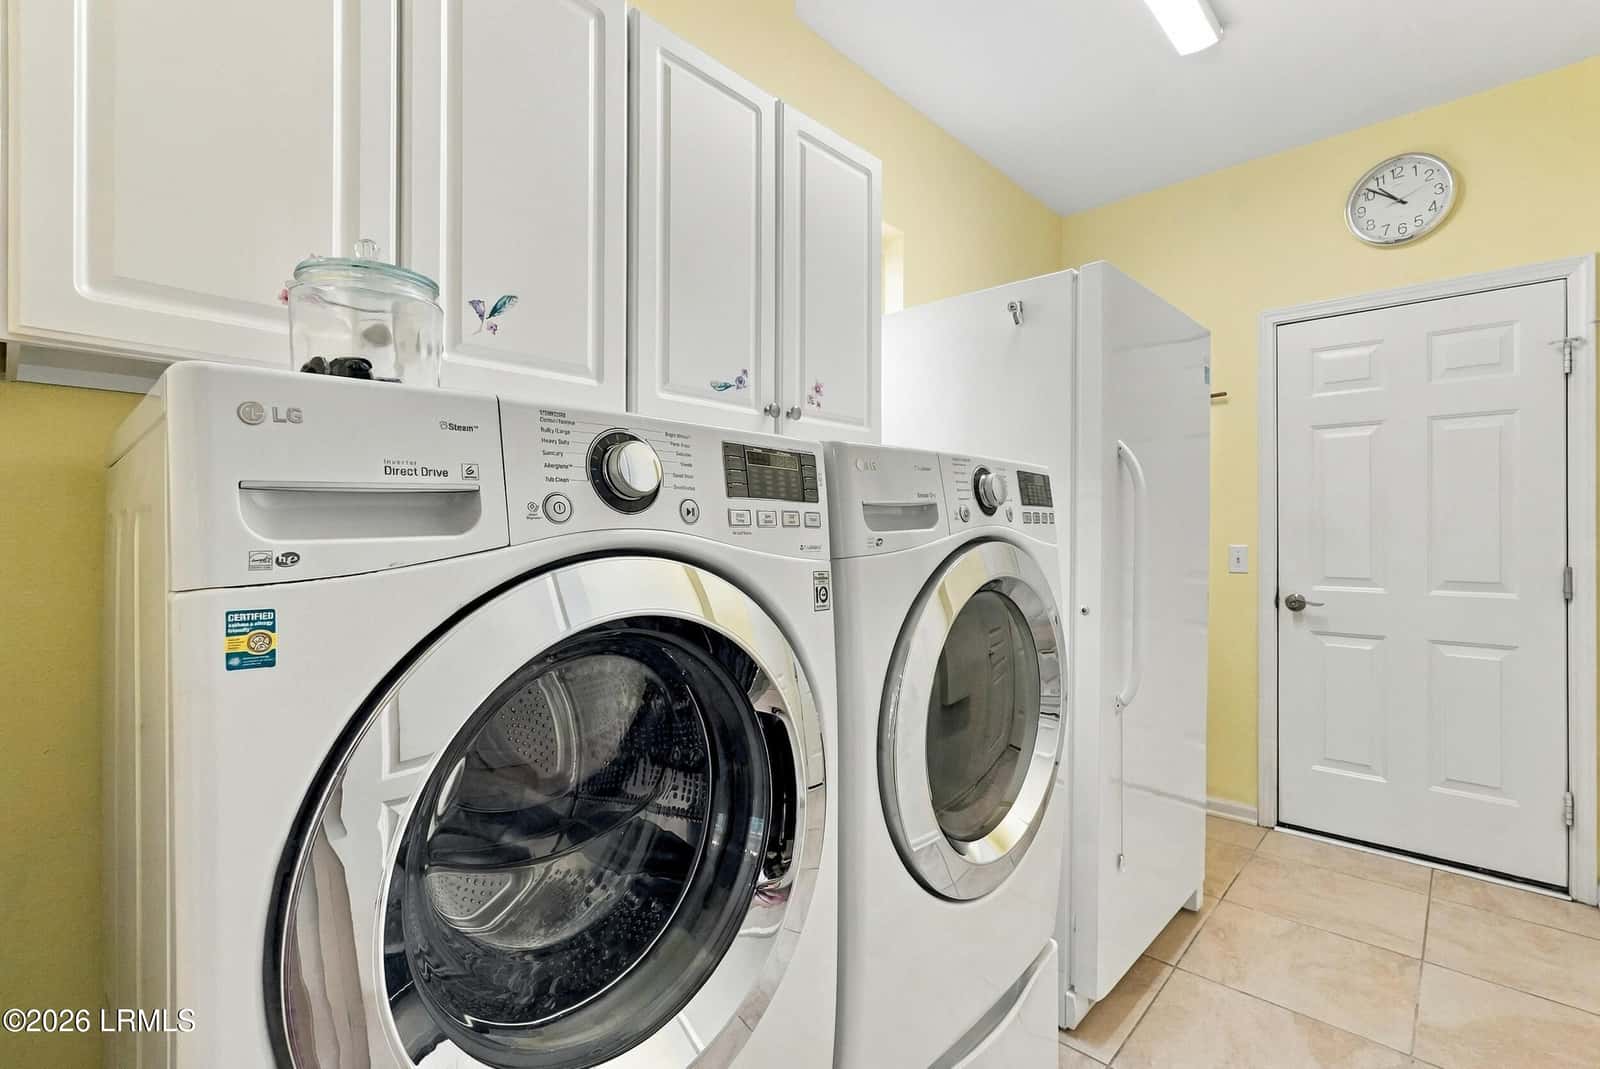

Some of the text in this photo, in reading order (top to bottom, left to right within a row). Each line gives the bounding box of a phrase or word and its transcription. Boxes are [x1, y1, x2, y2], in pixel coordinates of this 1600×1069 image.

[1390, 166, 1405, 180] 12
[1412, 165, 1418, 177] 1
[1424, 168, 1434, 182] 2
[1375, 175, 1385, 187] 11
[1434, 182, 1444, 195] 3
[1362, 190, 1376, 202] 10
[1357, 206, 1366, 218] 9
[1428, 200, 1438, 212] 4
[1366, 218, 1376, 231] 8
[1414, 214, 1424, 227] 5
[1382, 223, 1391, 236] 7
[1397, 222, 1408, 235] 6
[271, 406, 304, 424] LG
[384, 465, 449, 478] Direct Drive
[227, 612, 274, 622] CERTIFIED
